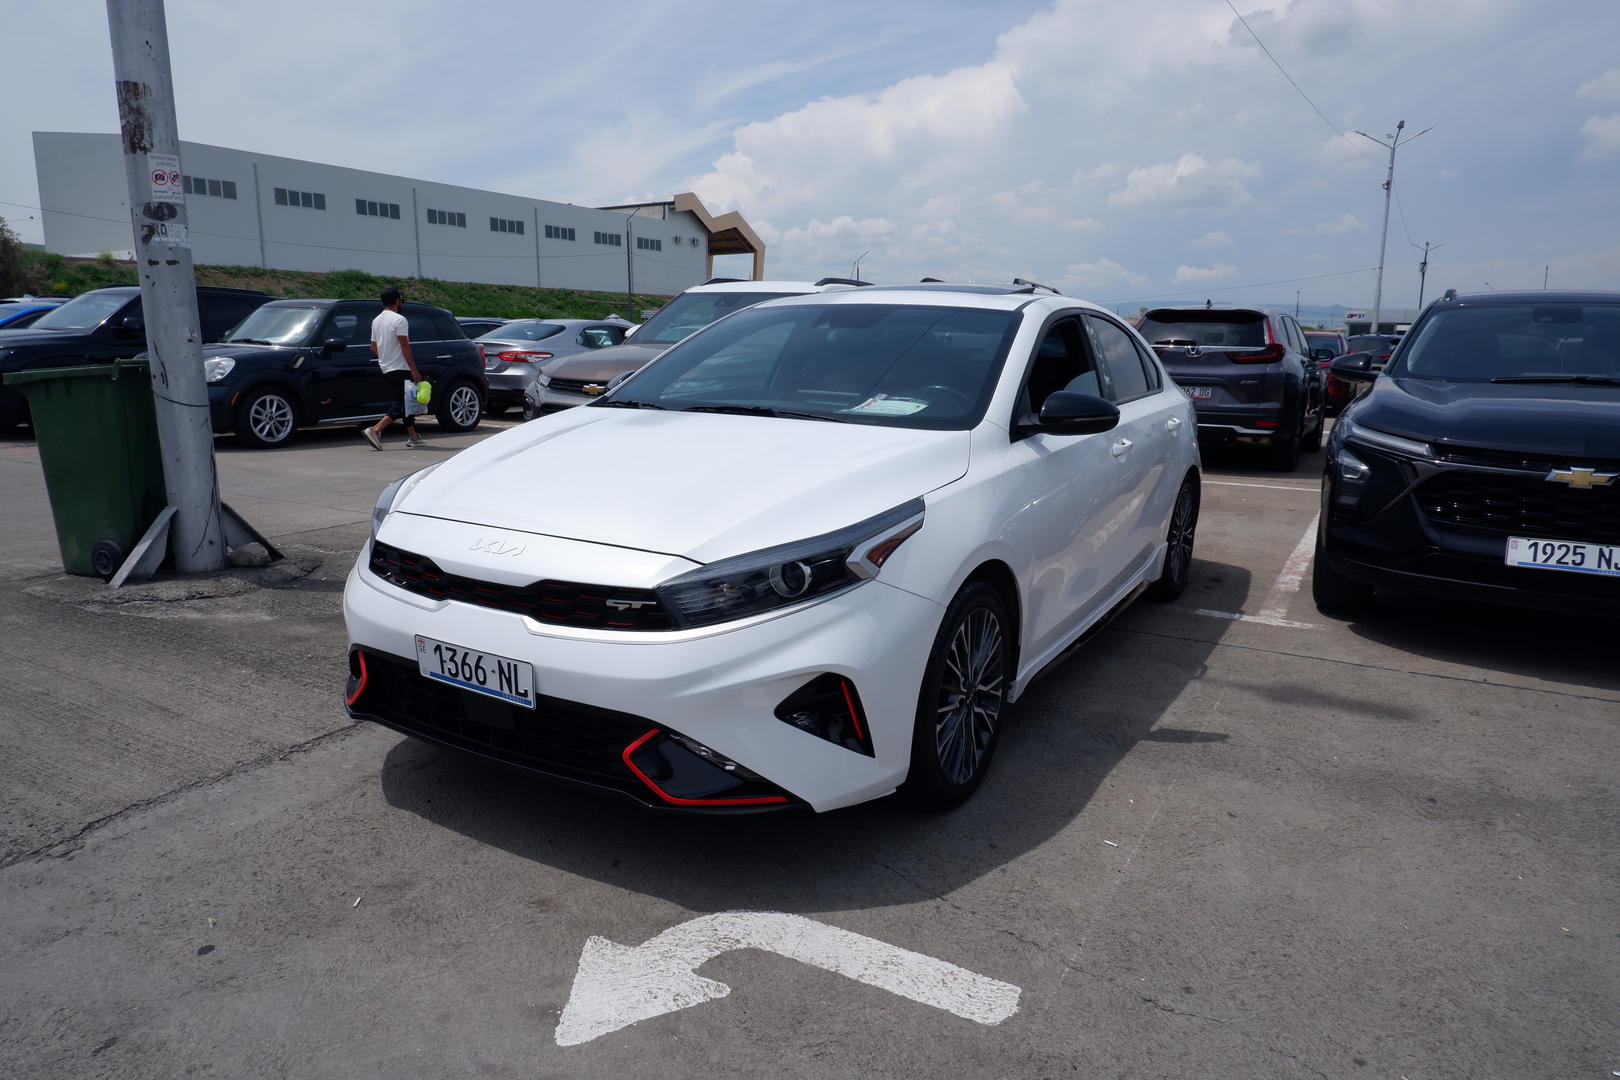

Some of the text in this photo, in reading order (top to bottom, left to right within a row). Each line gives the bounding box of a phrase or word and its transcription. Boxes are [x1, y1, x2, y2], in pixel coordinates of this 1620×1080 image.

[1528, 541, 1586, 567] 1925
[434, 643, 529, 698] 1366 NL
